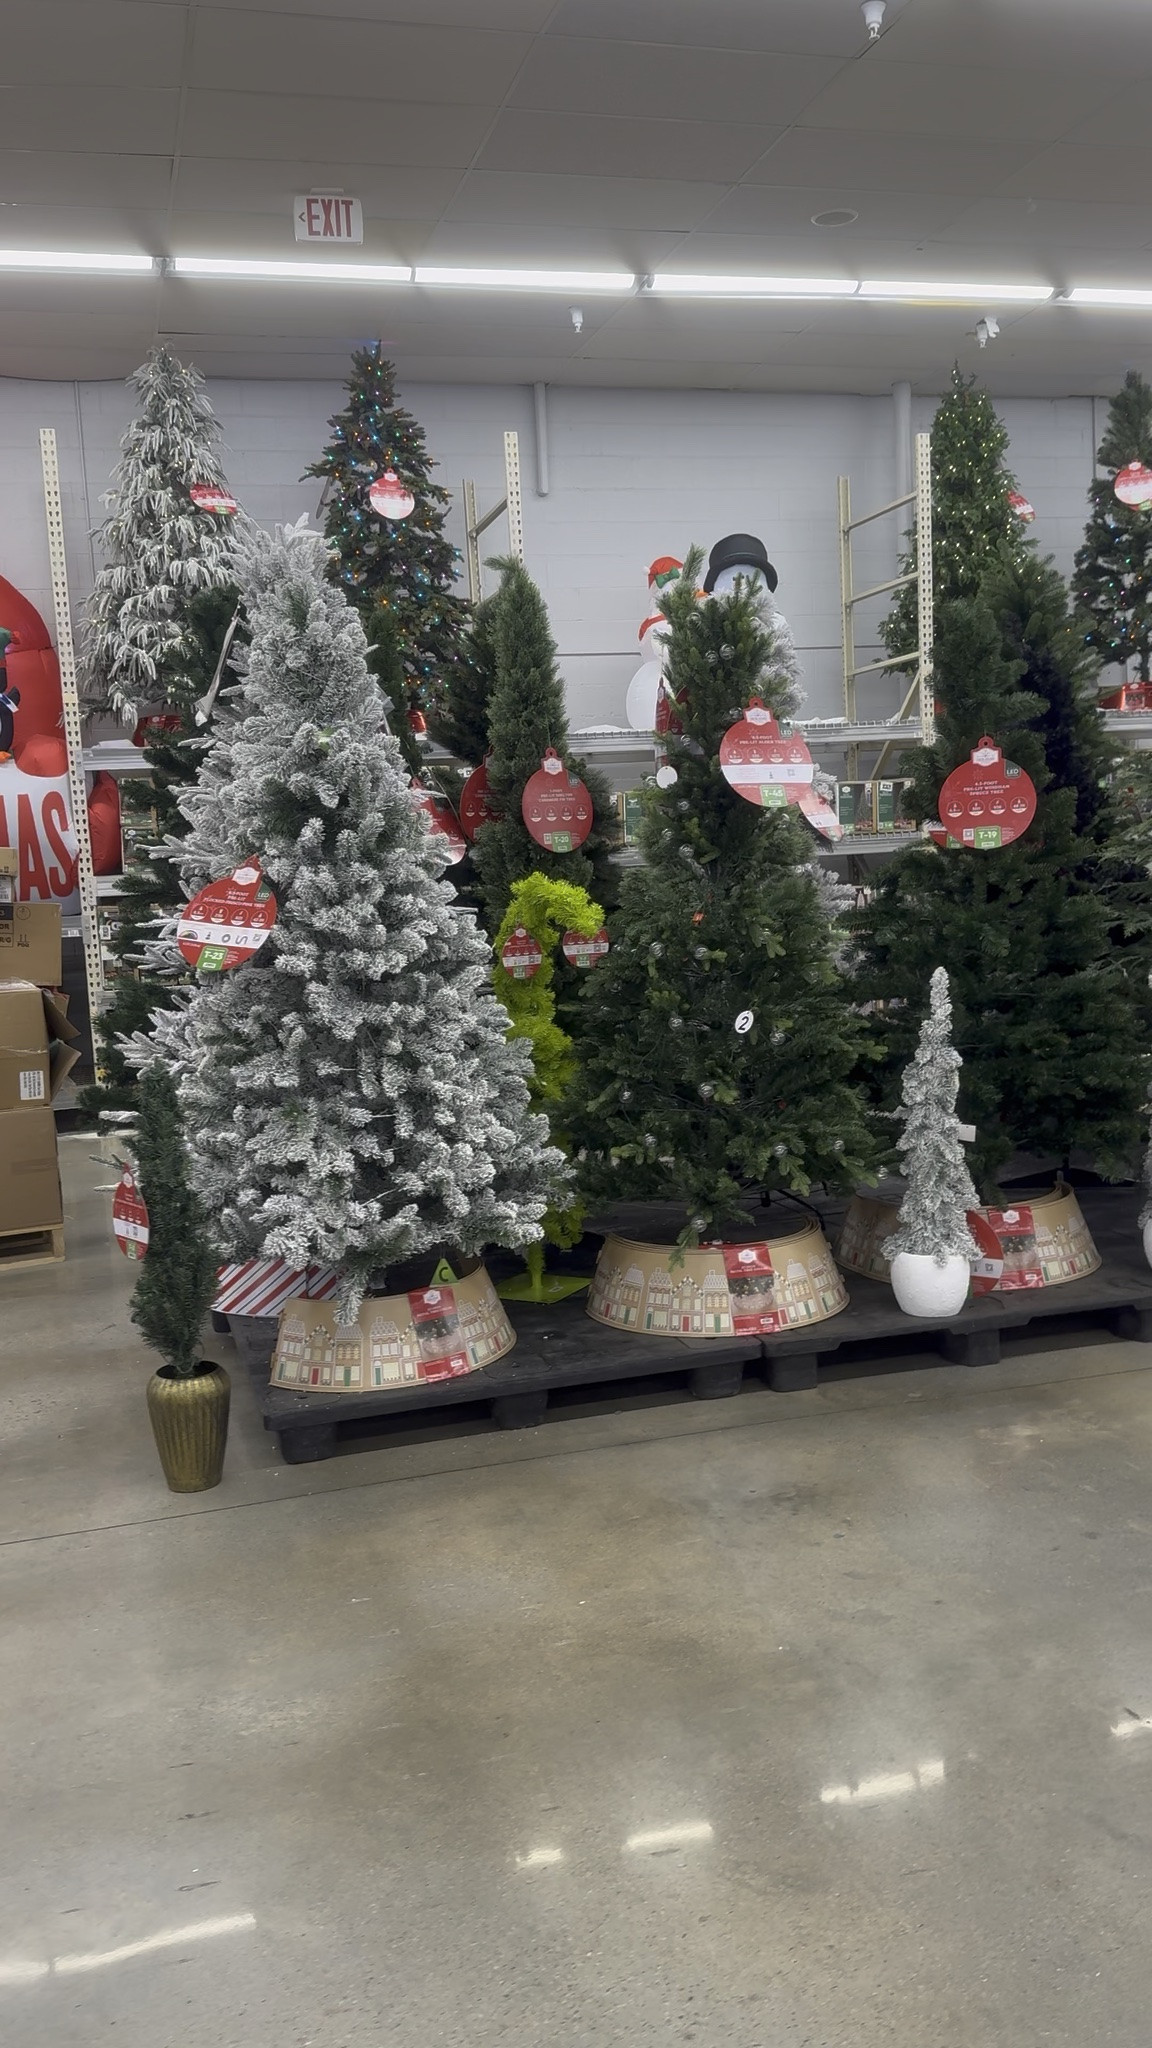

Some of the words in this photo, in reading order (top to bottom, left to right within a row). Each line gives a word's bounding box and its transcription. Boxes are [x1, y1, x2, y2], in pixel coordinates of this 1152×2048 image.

[306, 198, 353, 238] EXIT
[978, 831, 998, 839] T-19
[0, 790, 74, 902] AS
[204, 950, 224, 960] T-23
[738, 1016, 749, 1030] 2
